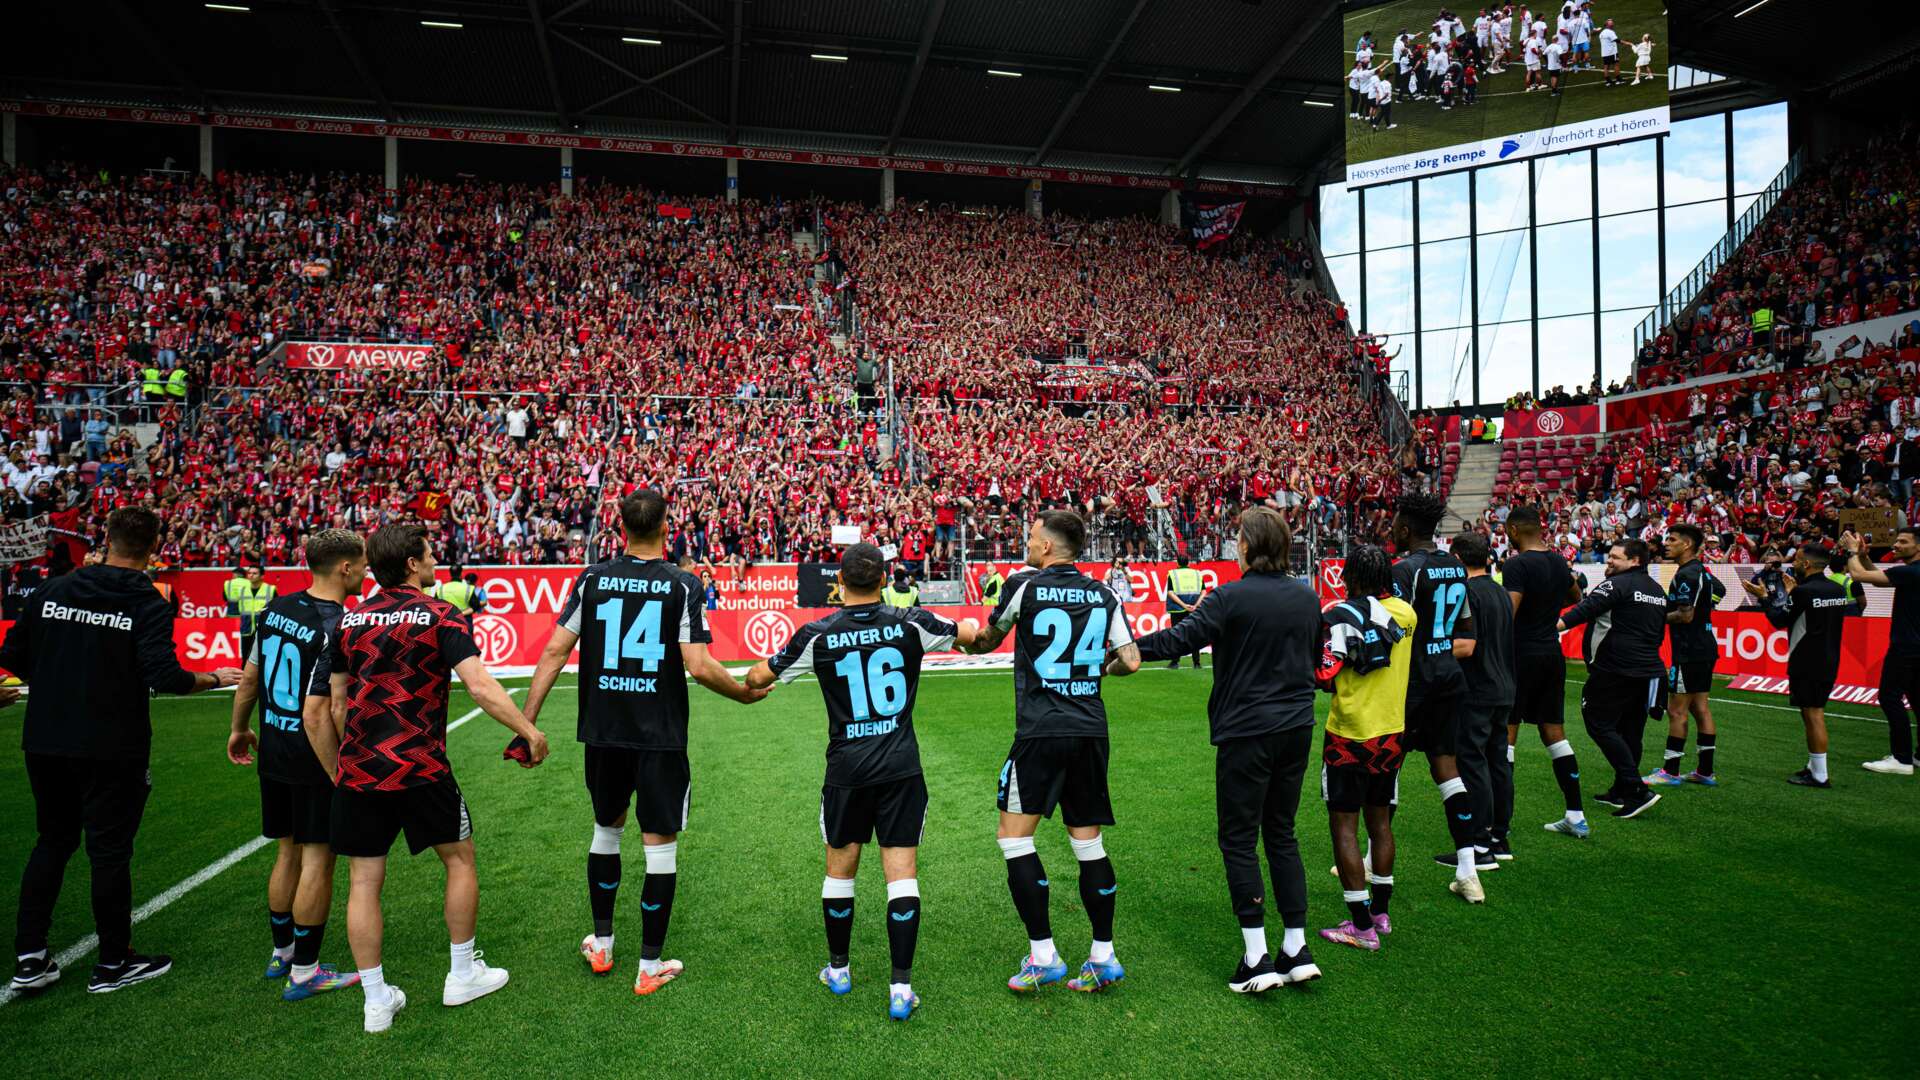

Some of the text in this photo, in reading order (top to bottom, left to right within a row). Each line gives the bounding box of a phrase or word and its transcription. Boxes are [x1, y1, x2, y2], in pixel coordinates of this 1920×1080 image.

[1541, 116, 1660, 147] Unerhört gut hören.
[1351, 148, 1486, 181] Hörsysteme Jörg Rempe
[598, 576, 672, 595] BAYER 04
[1427, 567, 1456, 580] BAYER
[1036, 587, 1103, 604] BAYER 04
[1433, 582, 1467, 639] 12
[41, 601, 133, 631] Barmenia
[265, 611, 315, 643] BAYER 04
[341, 607, 432, 629] Barmenia
[596, 597, 665, 672] 14
[826, 624, 904, 650] BAYER 04
[1032, 607, 1108, 680] 24
[262, 634, 301, 712] 10
[598, 676, 657, 693] SCHICK
[835, 647, 907, 721] 16
